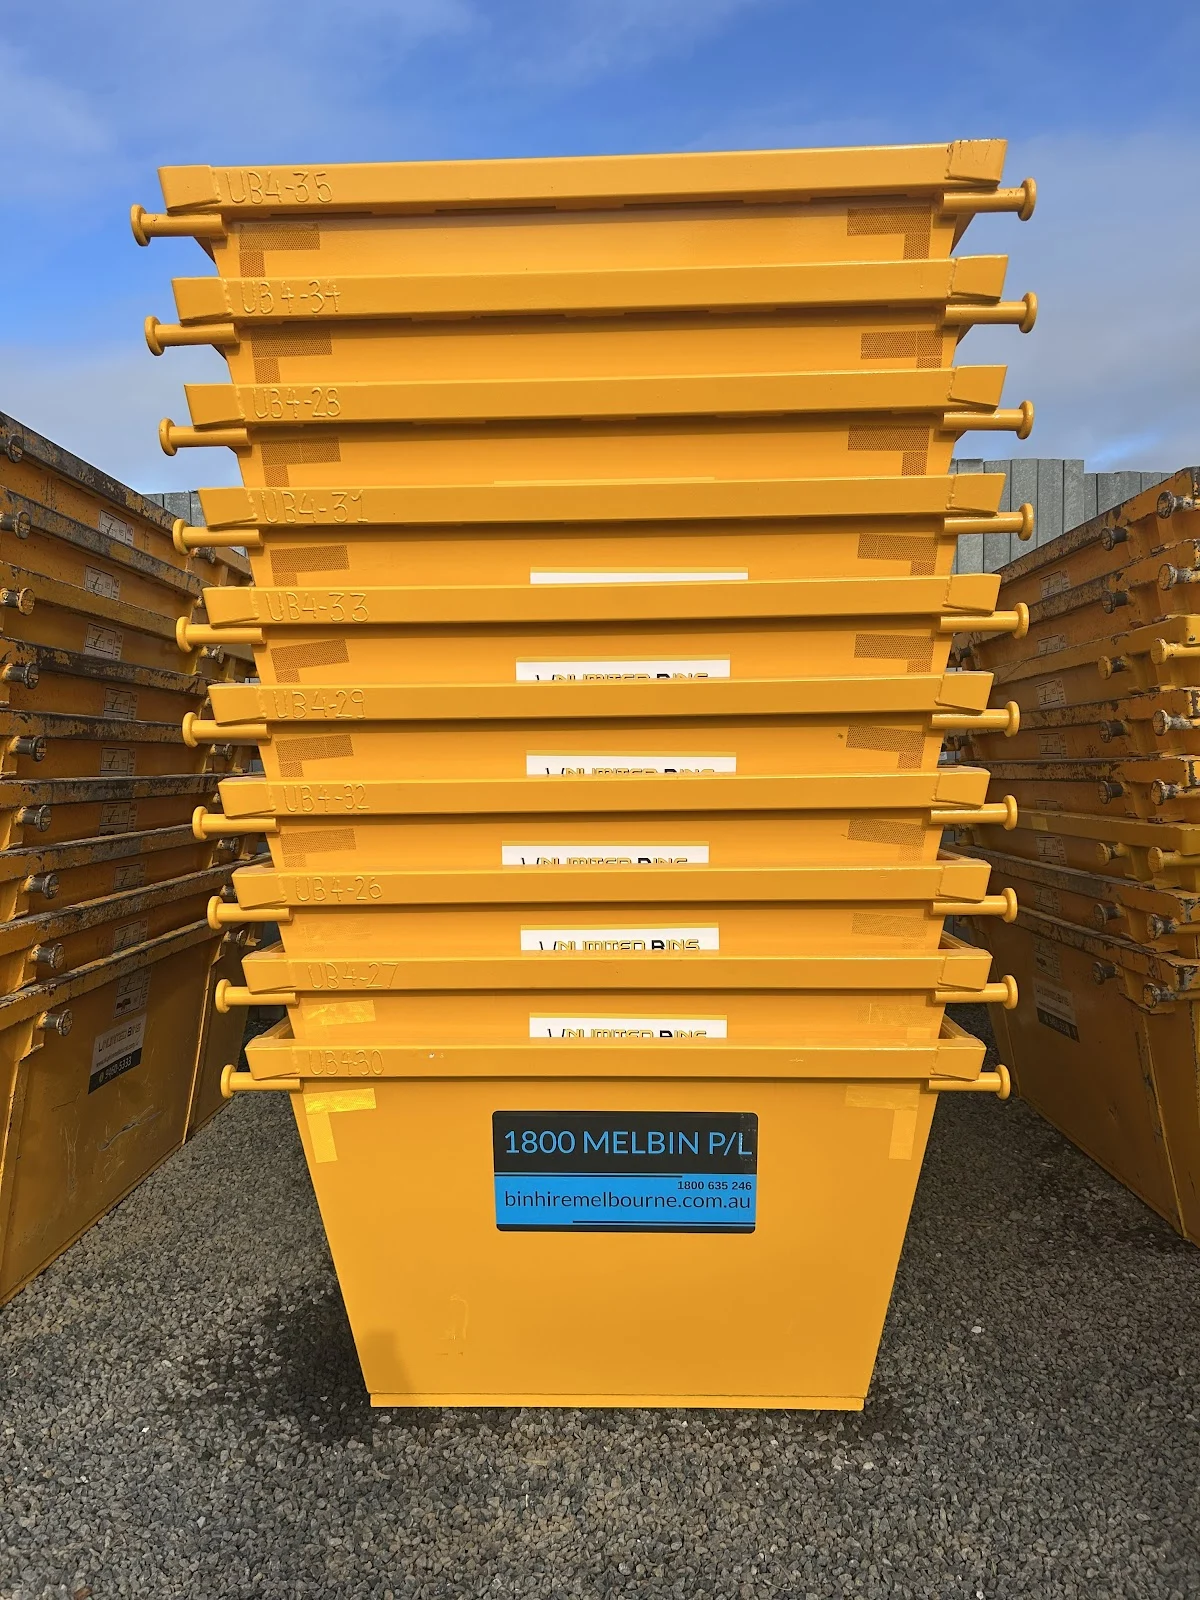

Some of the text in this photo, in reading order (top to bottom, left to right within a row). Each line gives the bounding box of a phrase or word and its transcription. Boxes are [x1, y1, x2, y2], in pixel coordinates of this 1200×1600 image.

[226, 171, 332, 204] UB4-35
[242, 280, 341, 314] UB4-34
[253, 387, 341, 418] UB4-28
[261, 489, 368, 523] UB4-31
[266, 592, 370, 622] UB4-33
[273, 689, 365, 719] UB4-29
[283, 783, 370, 812] UB4-32
[295, 876, 383, 901] UB4-26
[308, 962, 399, 989] UB4-27
[309, 1050, 384, 1075] UB4-30
[504, 1130, 753, 1156] 1800 MELBIN P/L
[505, 1191, 751, 1209] binhiremelbourne.com.au
[677, 1181, 752, 1191] 1800 635 246
